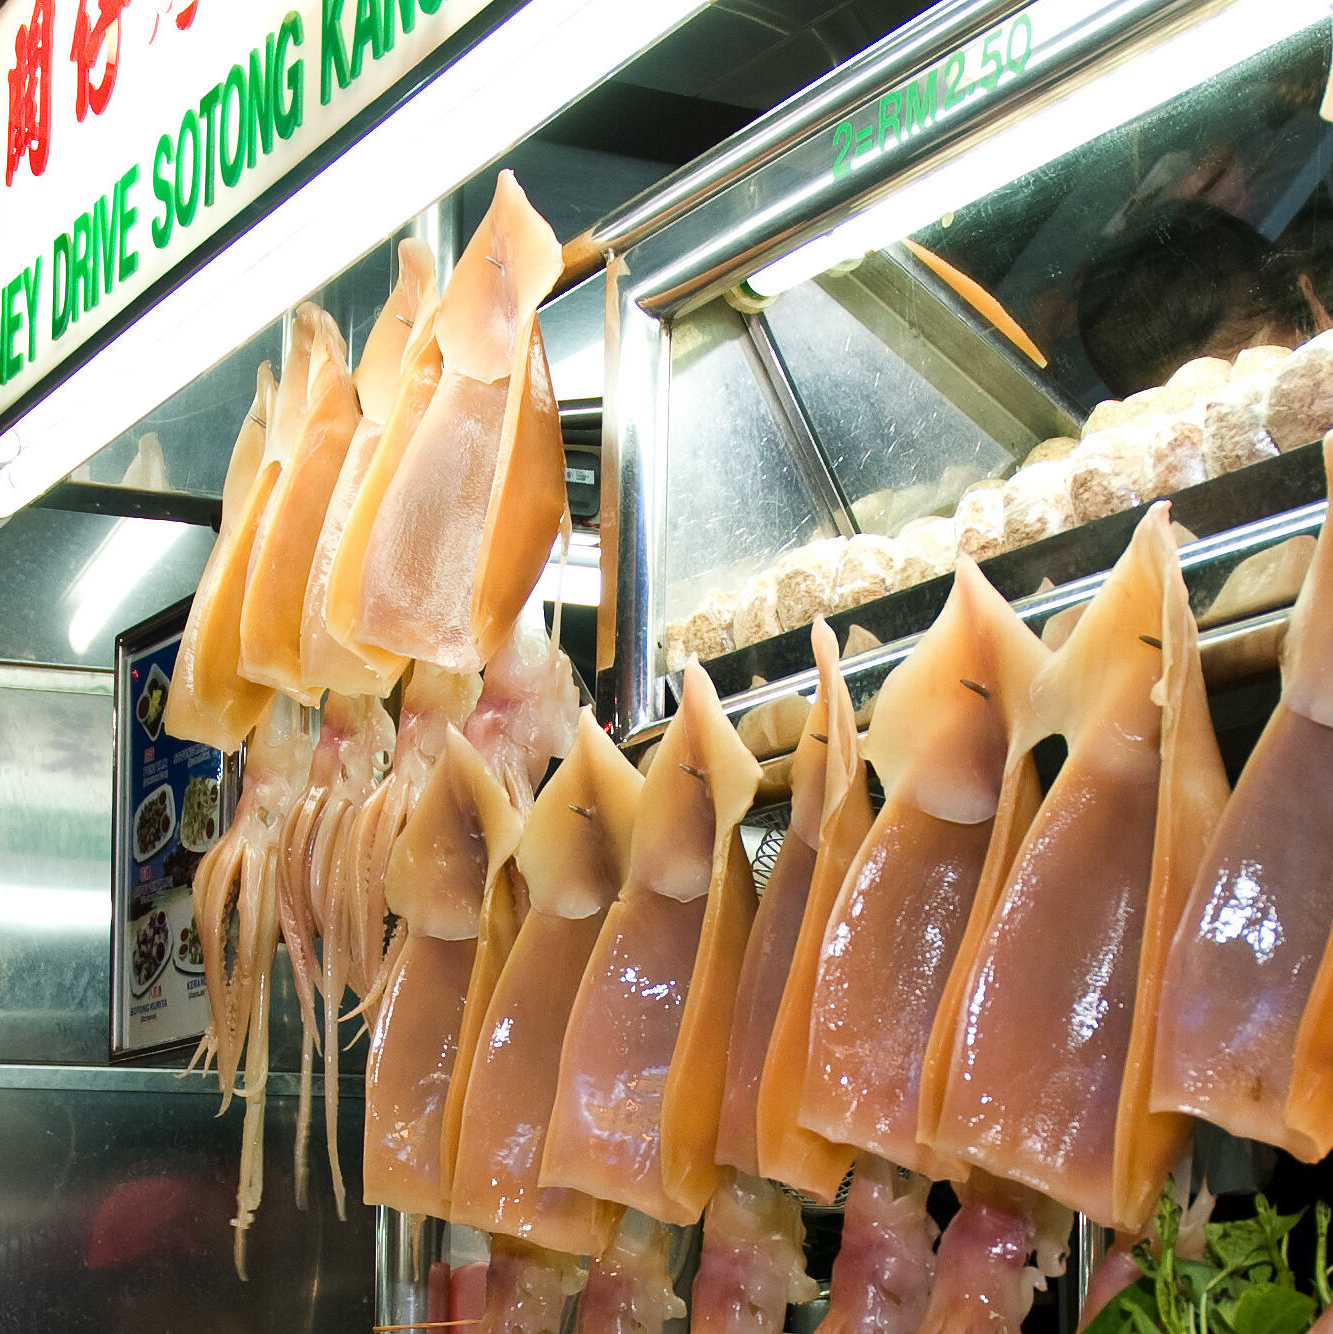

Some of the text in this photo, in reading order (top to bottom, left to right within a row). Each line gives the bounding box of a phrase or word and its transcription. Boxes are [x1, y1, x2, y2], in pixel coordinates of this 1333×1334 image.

[52, 163, 140, 341] DRIVE
[152, 10, 305, 249] SOTONG
[320, 0, 449, 106] KA
